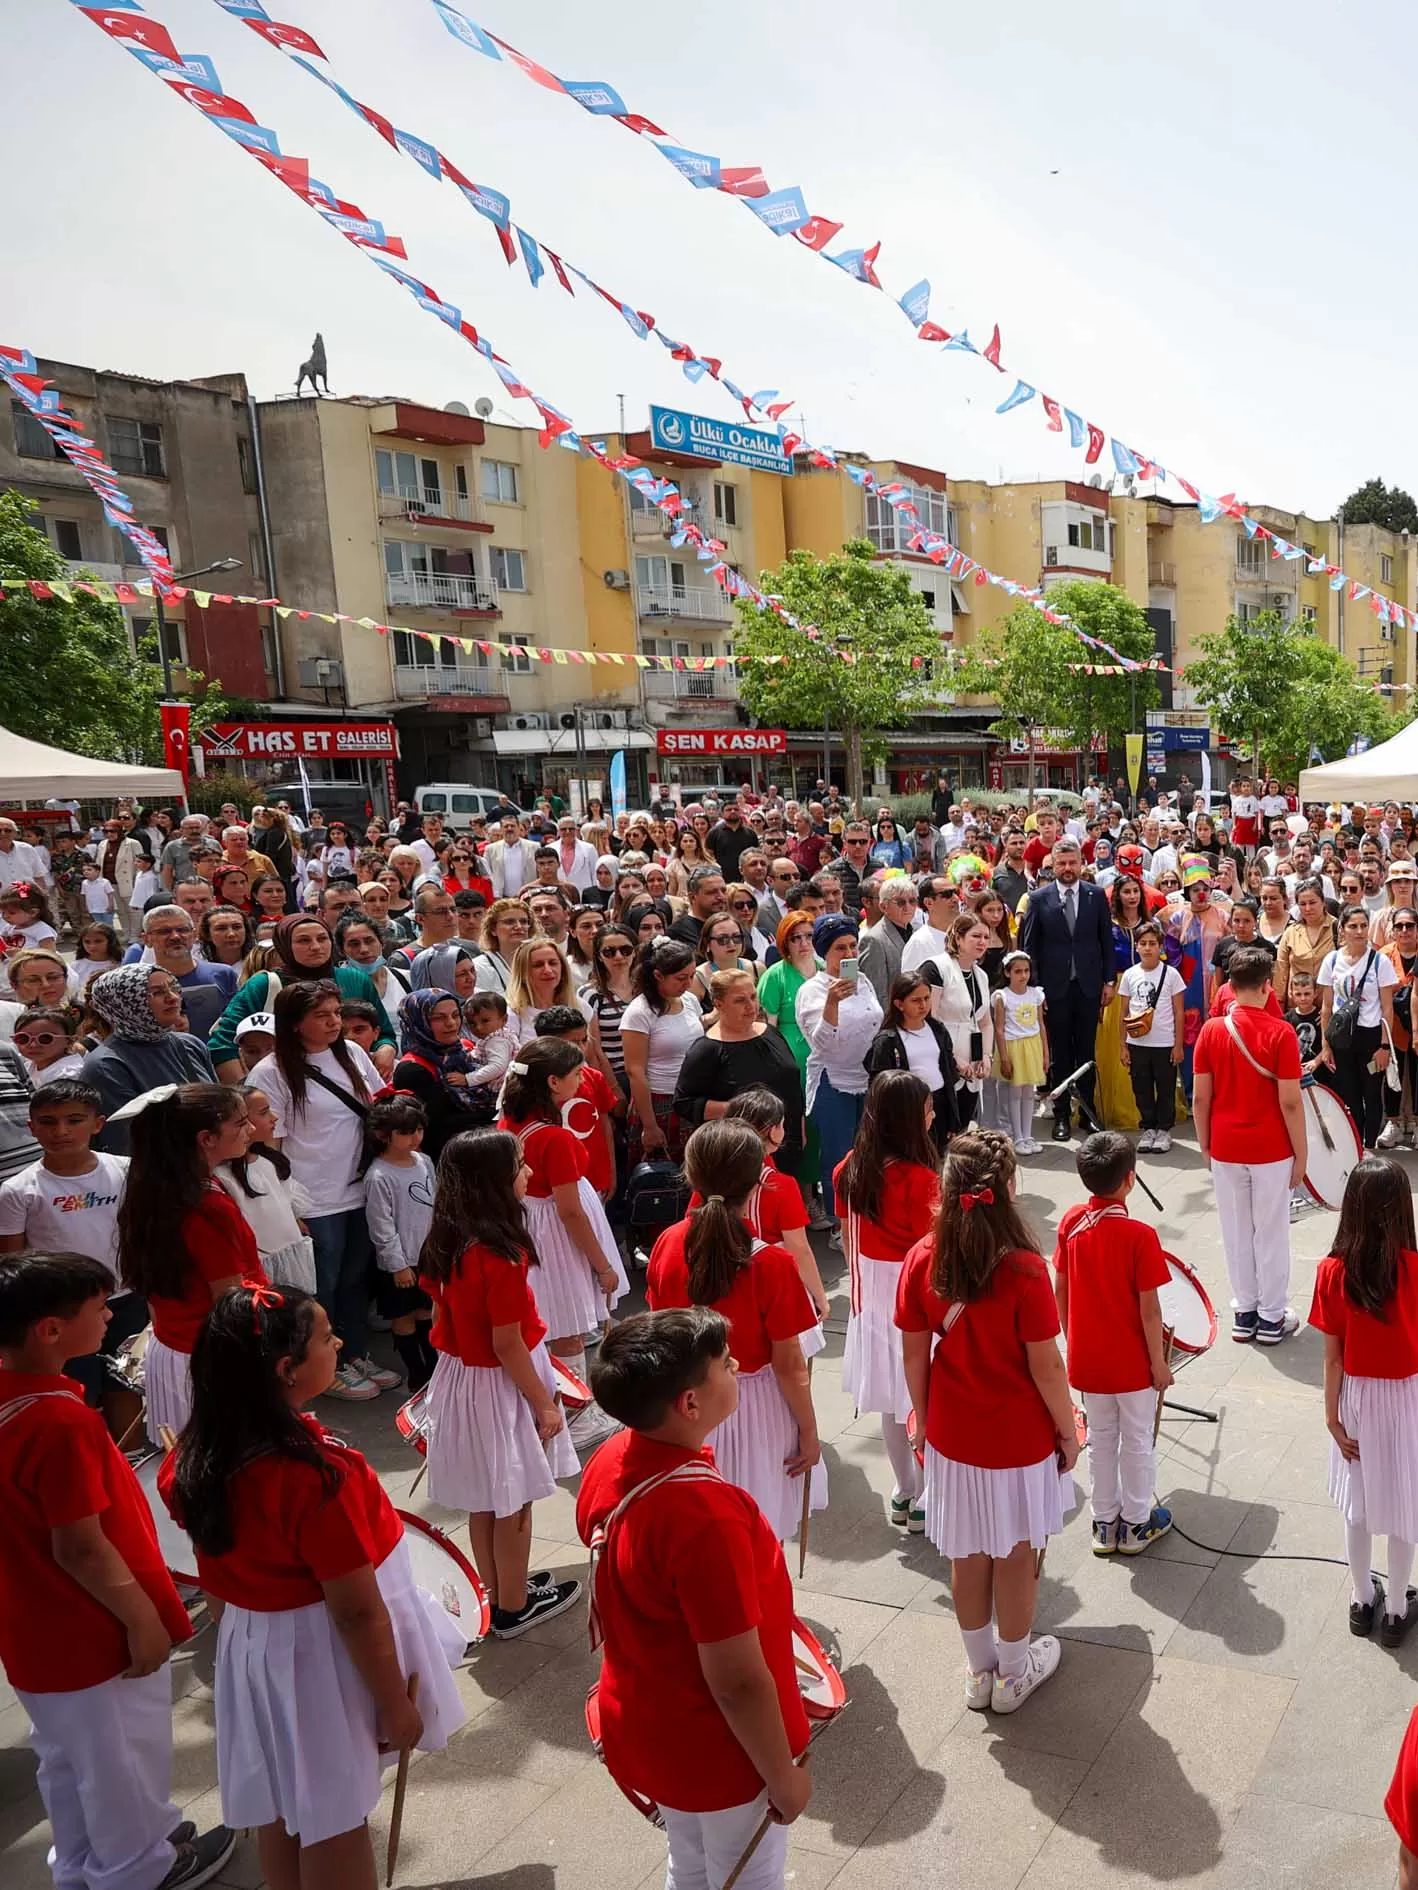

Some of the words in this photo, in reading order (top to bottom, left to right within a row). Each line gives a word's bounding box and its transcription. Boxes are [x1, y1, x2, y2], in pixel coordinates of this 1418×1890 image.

[689, 415, 723, 442] Ülkü
[692, 443, 718, 457] BUCA
[247, 731, 296, 752] HAS
[303, 731, 331, 751] ET
[336, 728, 391, 744] GALERİSİ
[664, 734, 705, 752] ŞEN
[713, 734, 781, 749] KASAP
[250, 1015, 270, 1026] W
[52, 1191, 97, 1206] PAUL
[61, 1194, 118, 1212] SMITH
